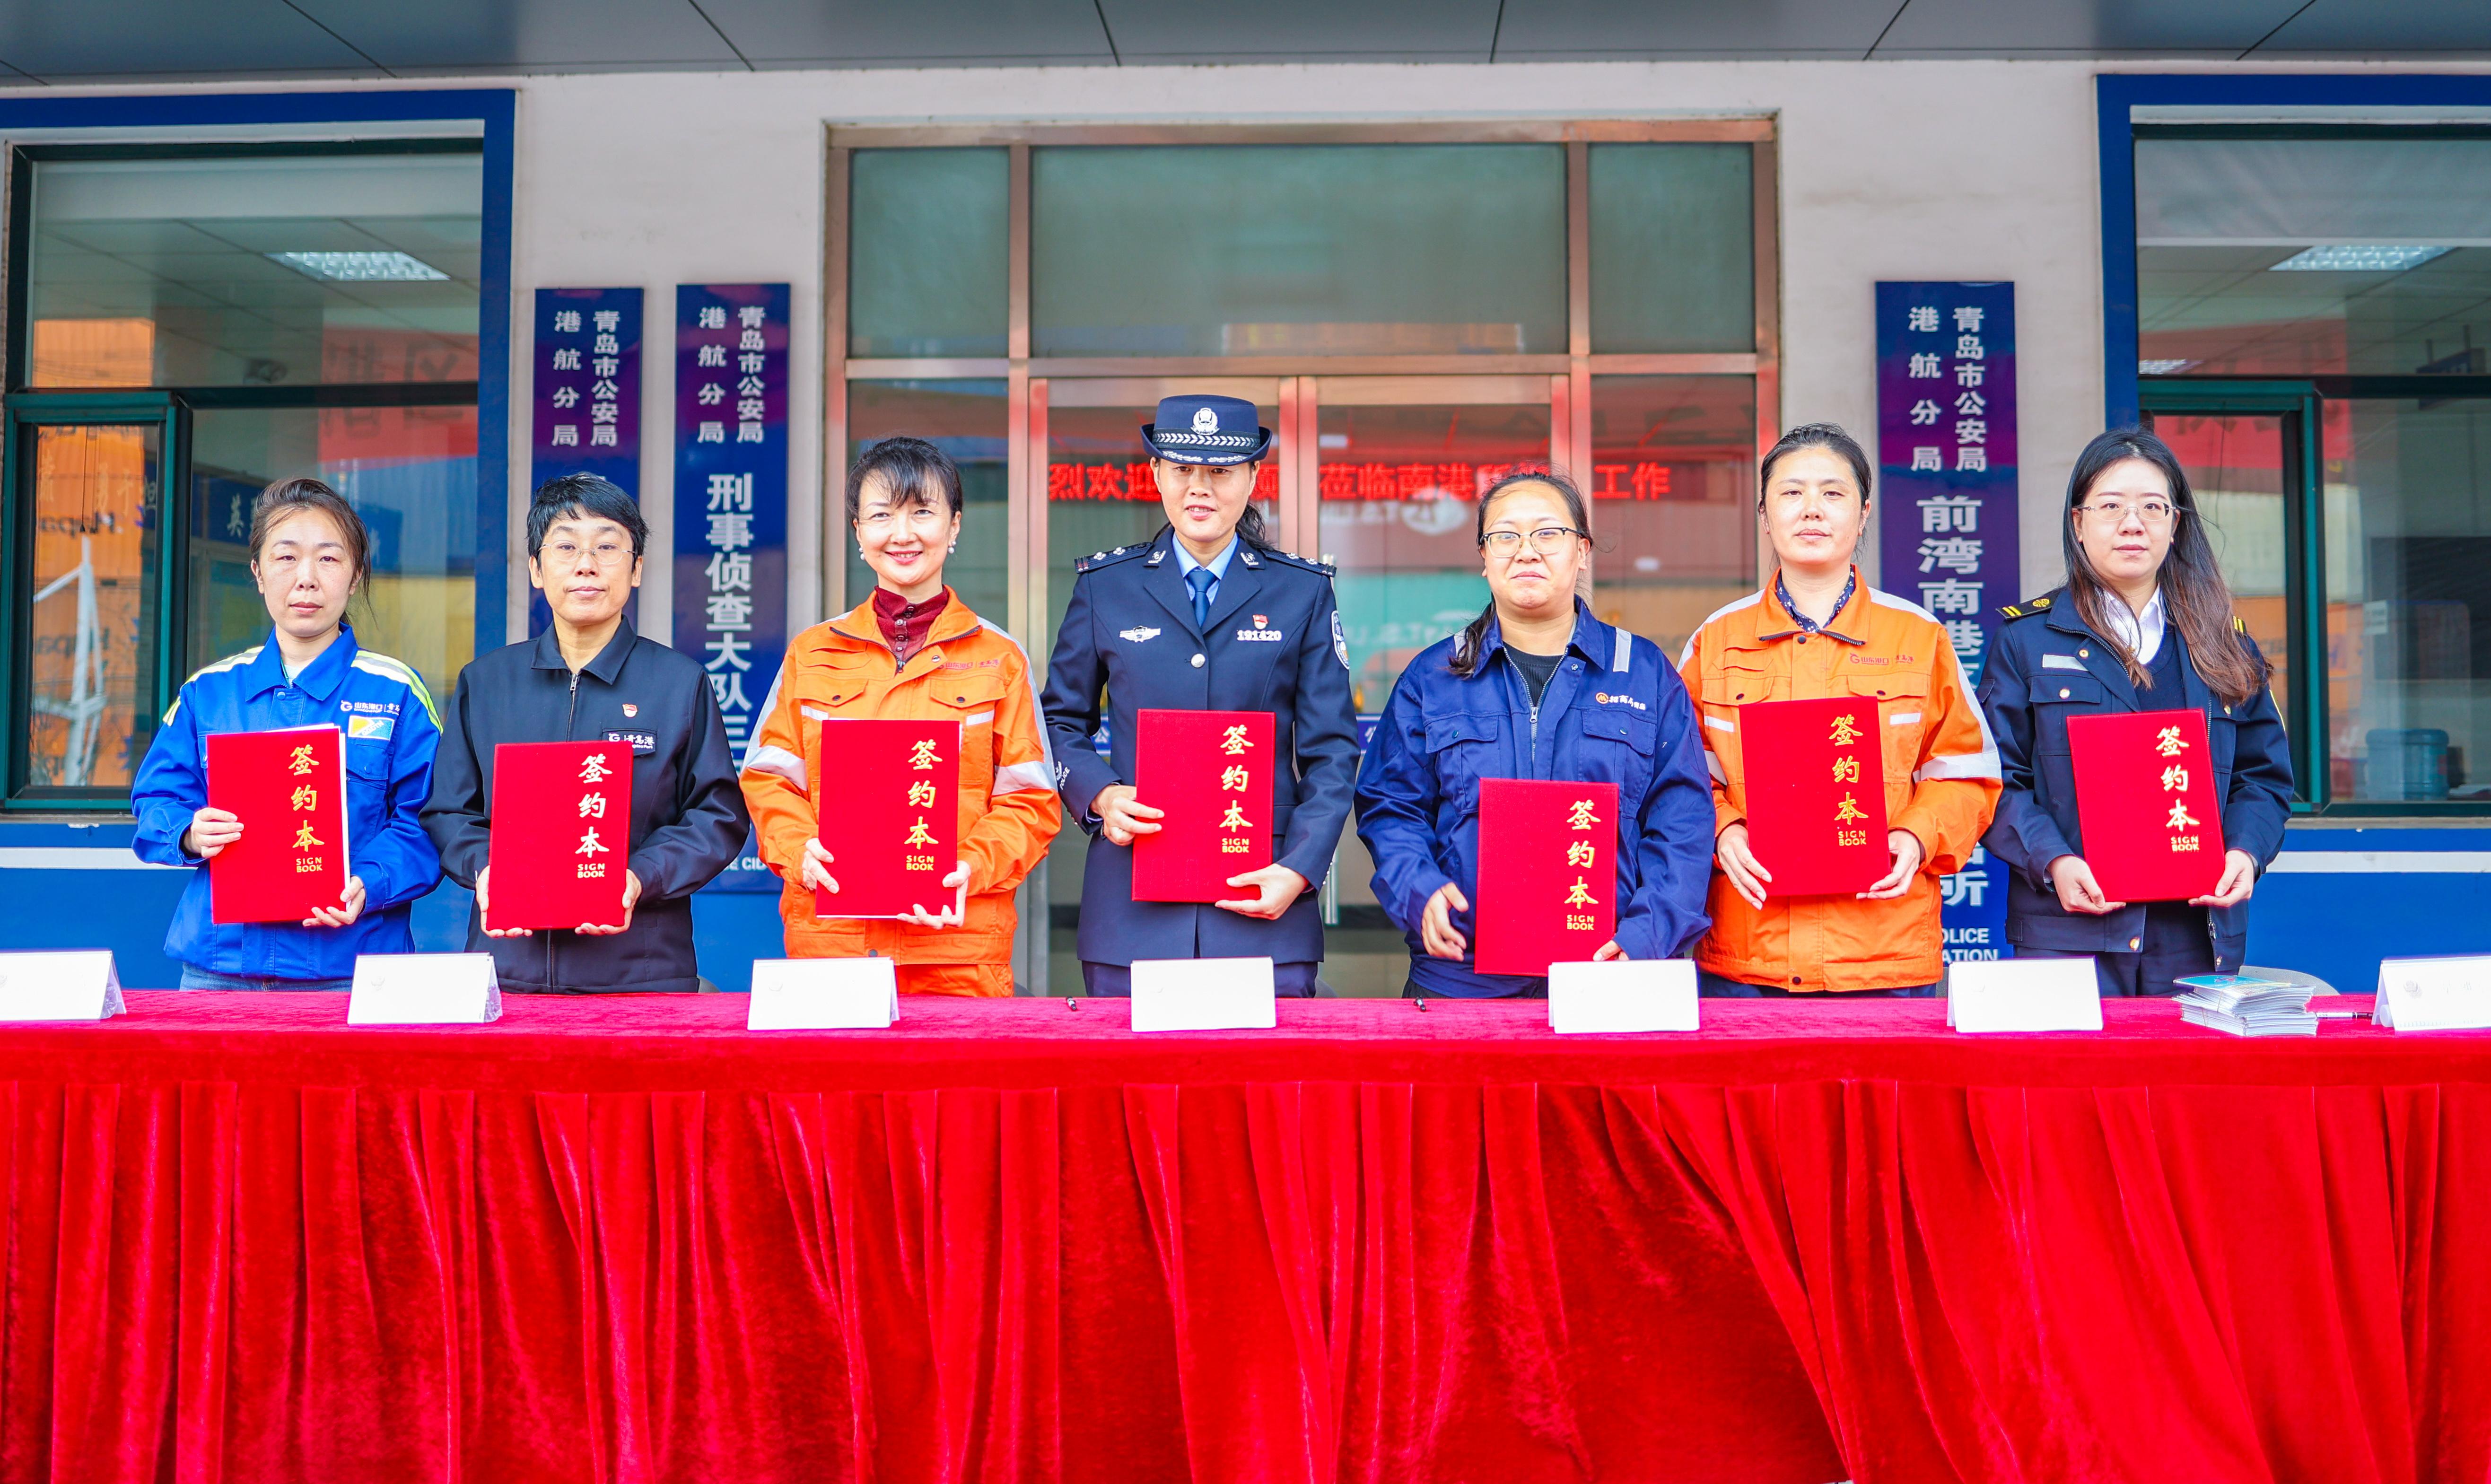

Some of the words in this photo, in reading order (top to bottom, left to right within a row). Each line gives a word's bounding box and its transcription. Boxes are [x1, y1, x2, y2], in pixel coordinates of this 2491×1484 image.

[551, 310, 582, 447] 港航分局
[591, 310, 620, 447] 青岛市公安局
[697, 306, 727, 444] 港航分局
[737, 306, 766, 444] 青岛市公安局
[1908, 306, 1942, 472] 港航分局
[1952, 306, 1987, 472] 青岛市公安局
[1592, 462, 1670, 500] 工作
[705, 473, 755, 776] 刑事侦查大队三
[1237, 629, 1283, 641] 191420
[289, 745, 325, 852] 签约本
[575, 754, 612, 858] 签约本
[904, 740, 943, 850] 签约本
[1219, 725, 1254, 833] 签约本
[1829, 715, 1869, 825] 签约本
[2156, 726, 2200, 832] 签约本
[297, 857, 322, 866] SIGN
[297, 864, 323, 873] BOOK
[577, 871, 605, 879] BOOK
[906, 863, 934, 871] BOOK
[907, 855, 934, 863] SIGN
[1565, 800, 1601, 910] 签约本
[1838, 830, 1866, 838] SIGN
[1839, 838, 1867, 846] BOOK
[2171, 836, 2199, 845] SIGN
[2172, 844, 2200, 852] BOOK
[1567, 915, 1594, 923] SIGN
[1567, 922, 1594, 931] BOOK
